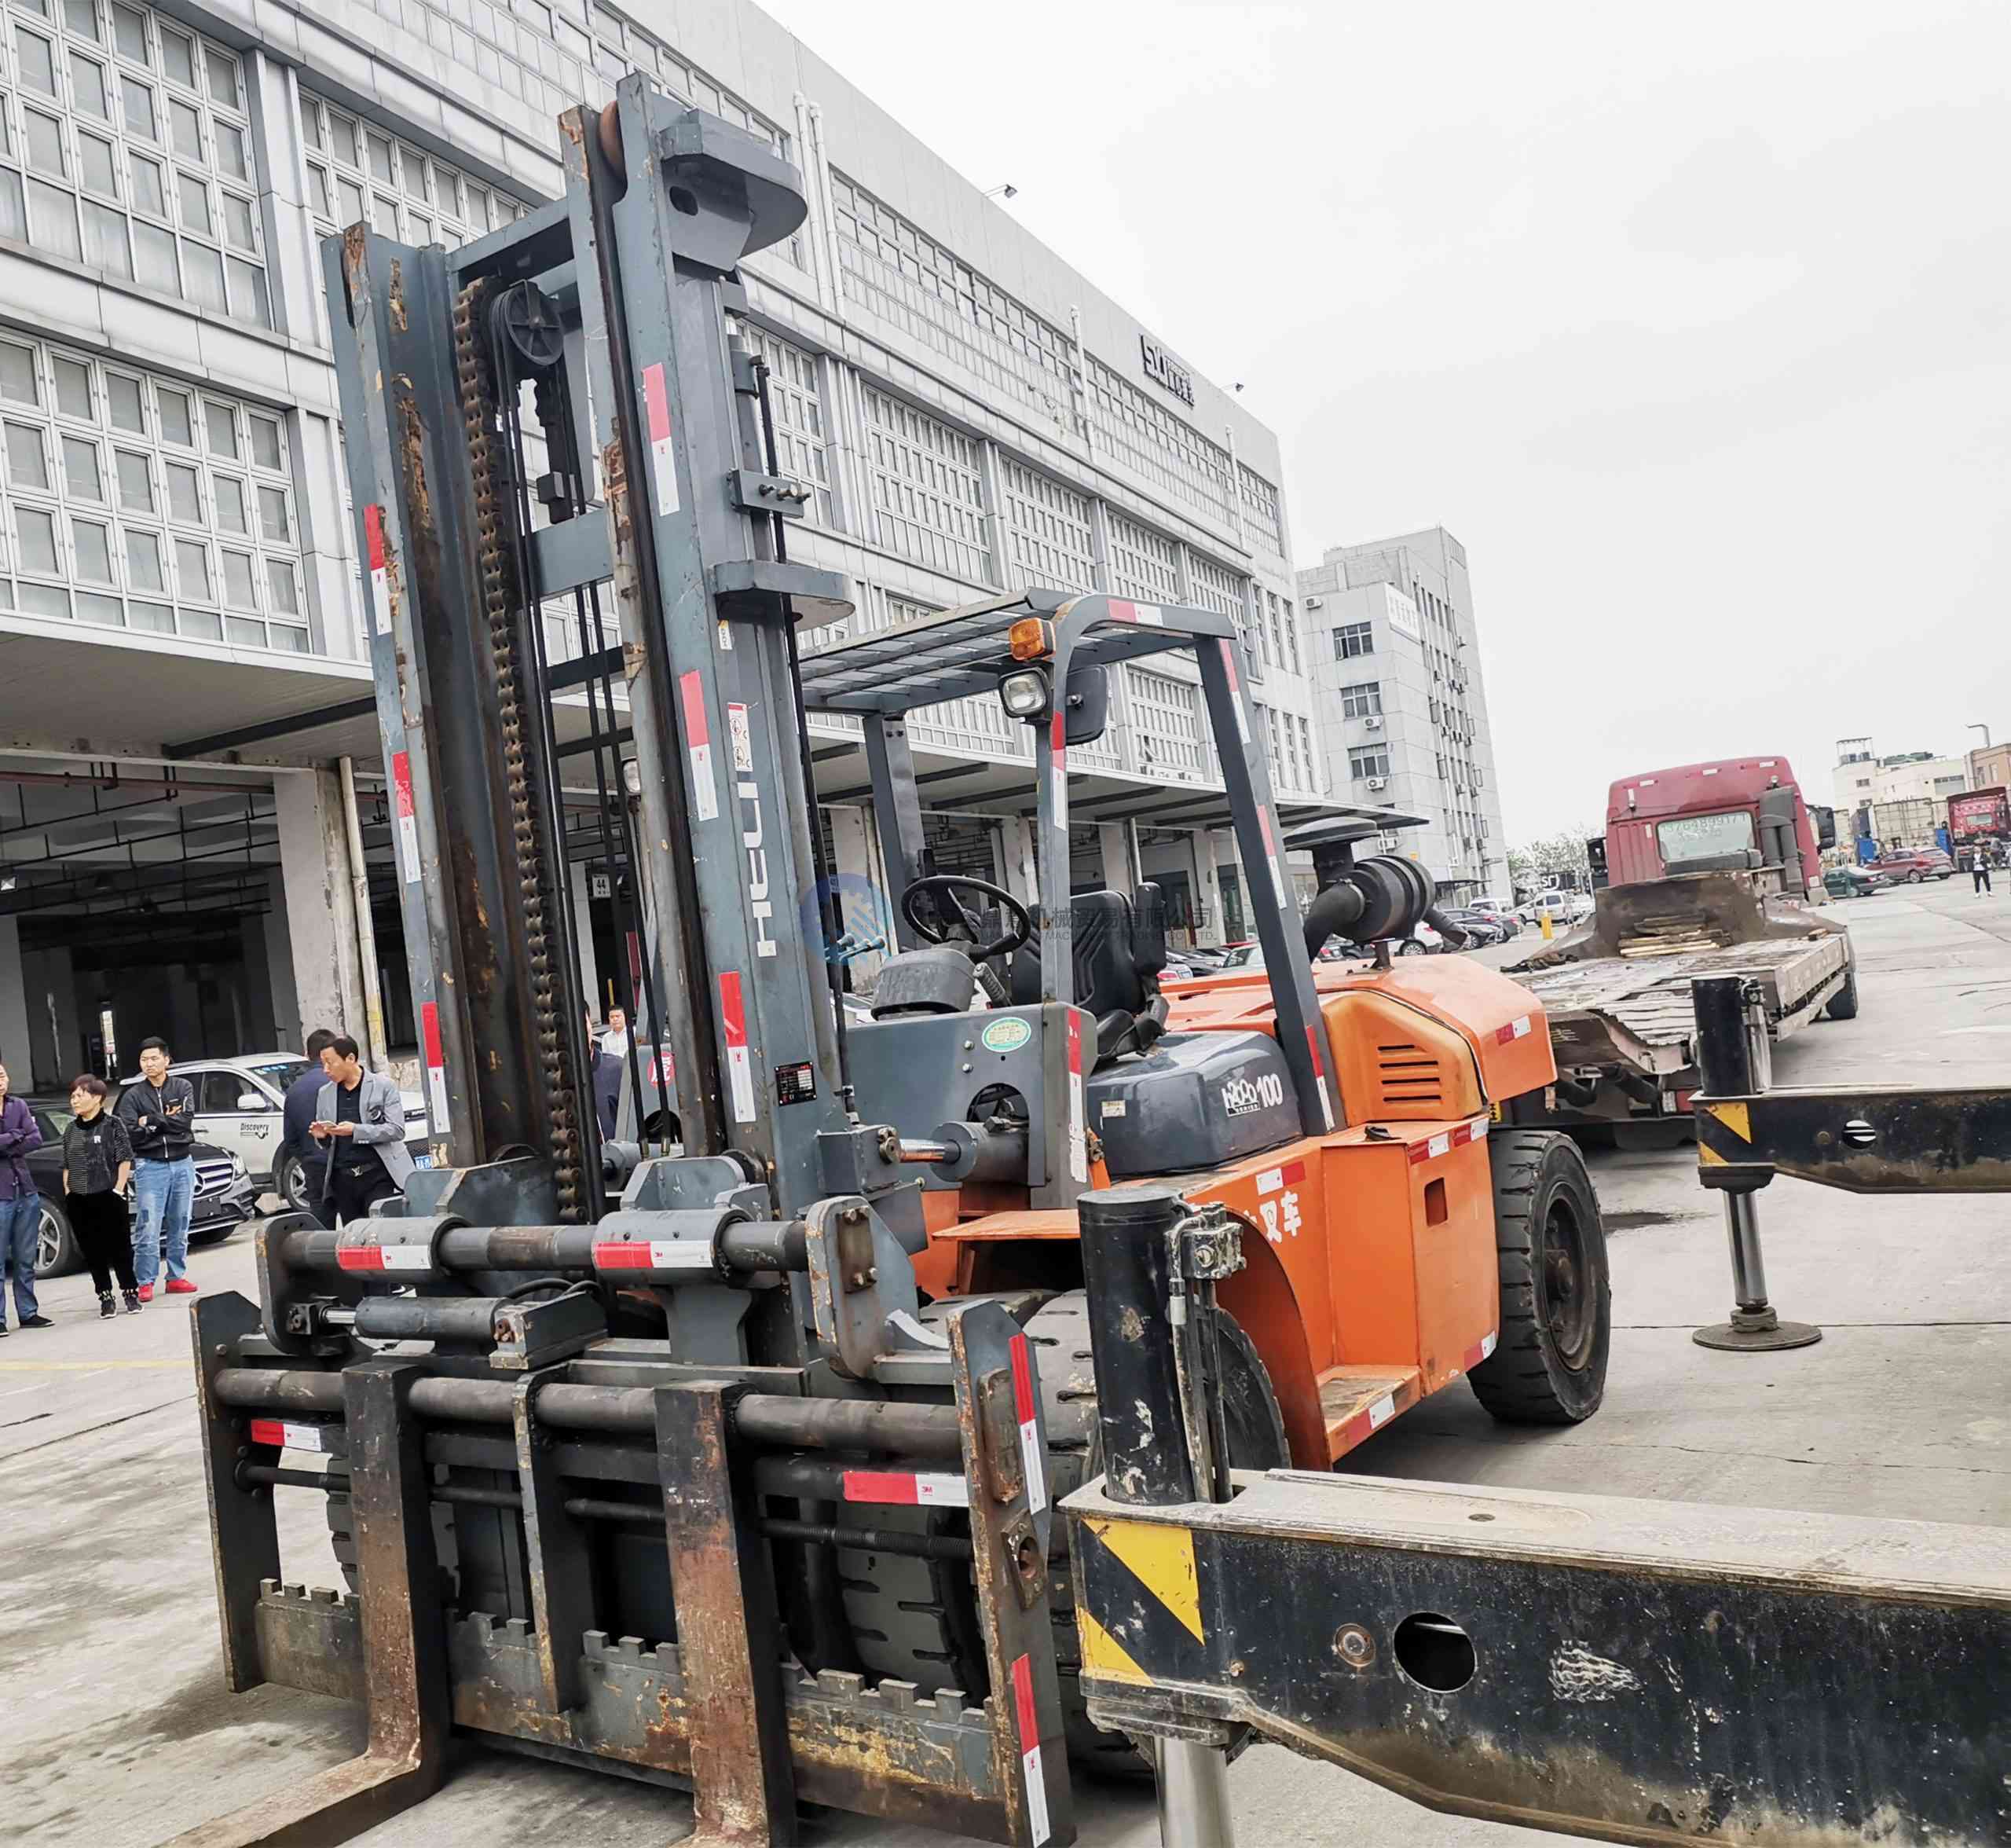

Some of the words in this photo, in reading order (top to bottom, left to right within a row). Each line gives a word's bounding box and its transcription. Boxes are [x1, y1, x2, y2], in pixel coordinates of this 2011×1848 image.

[1256, 1073, 1283, 1108] 100
[240, 1122, 270, 1132] Discovery
[1250, 1190, 1302, 1244] 叉车
